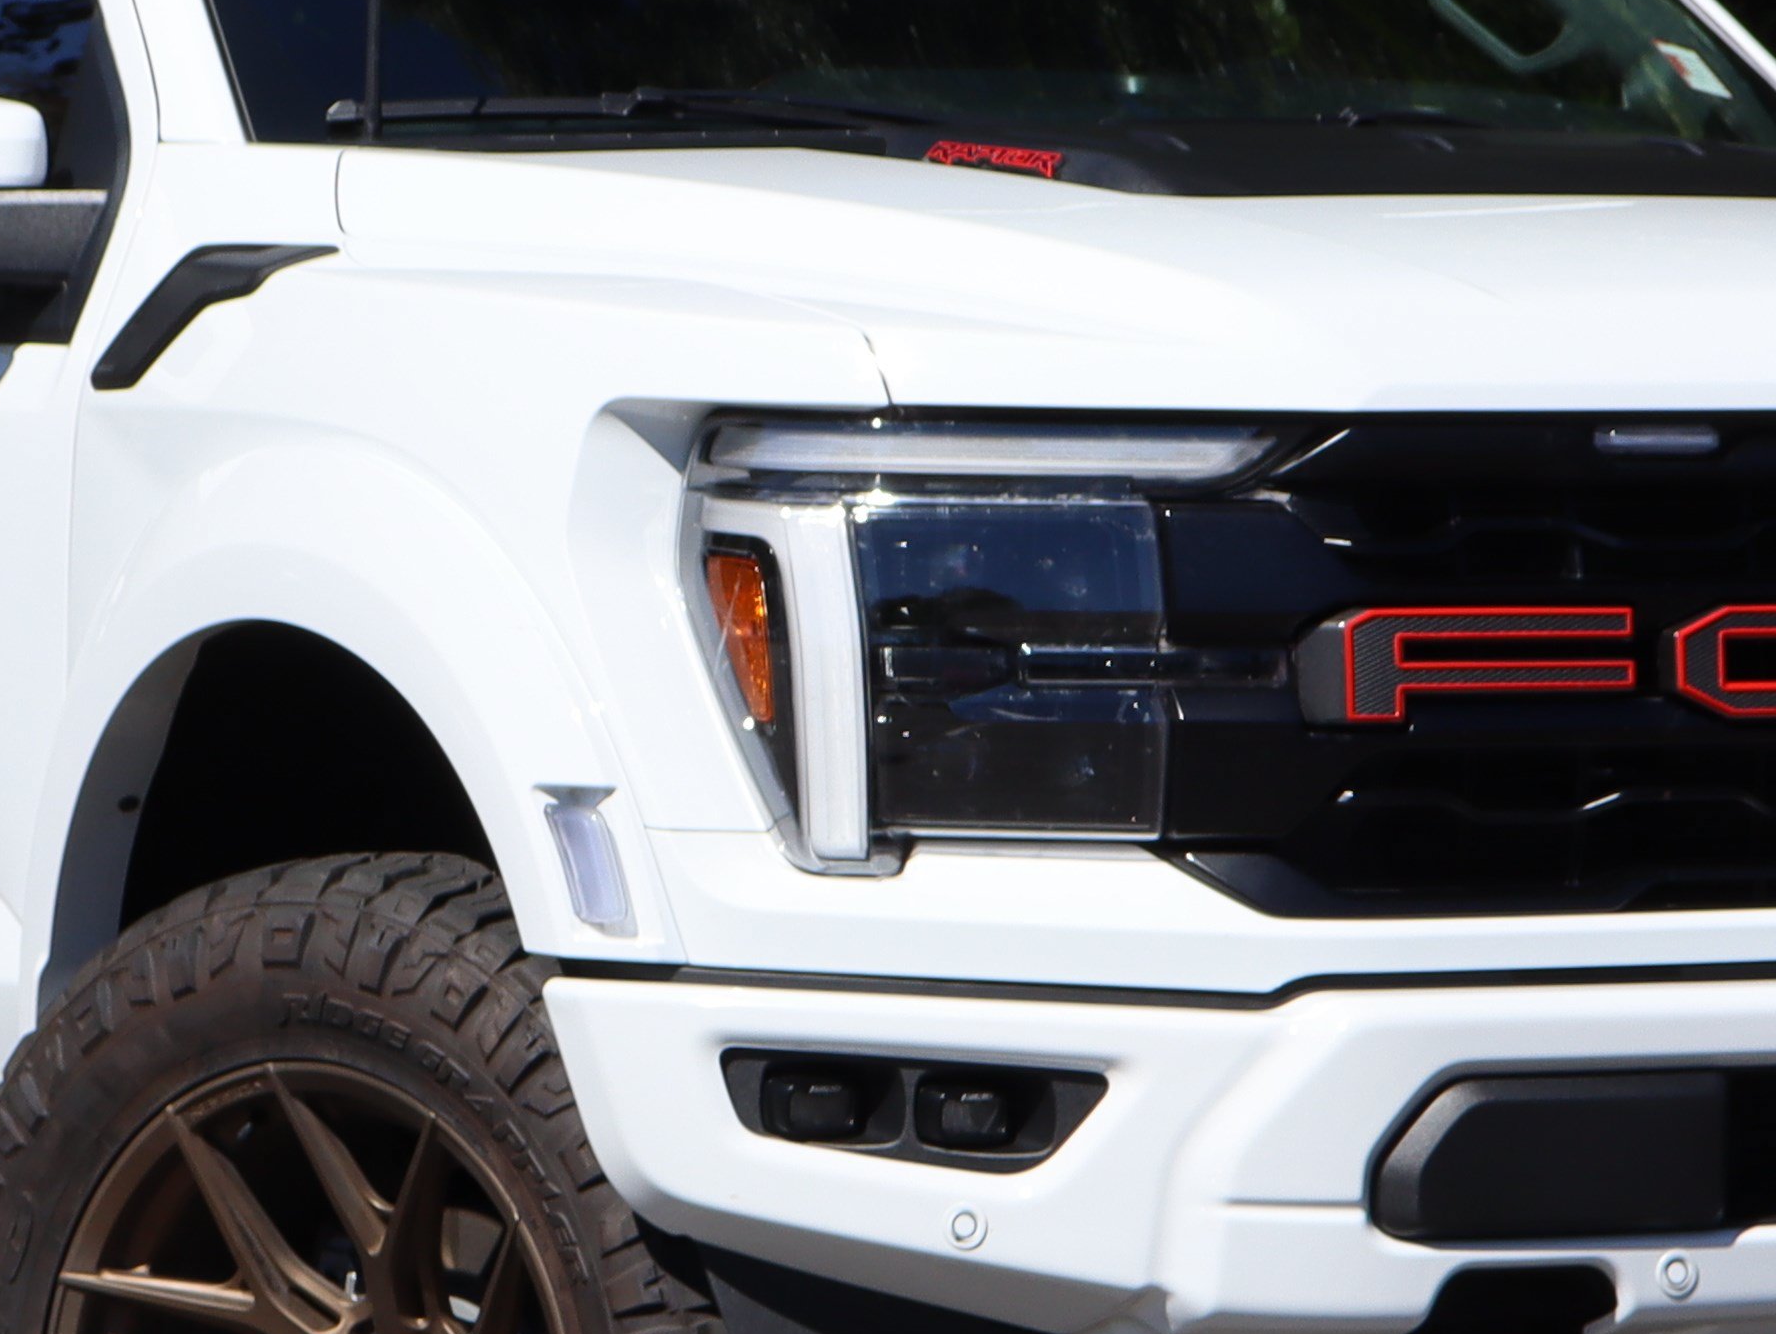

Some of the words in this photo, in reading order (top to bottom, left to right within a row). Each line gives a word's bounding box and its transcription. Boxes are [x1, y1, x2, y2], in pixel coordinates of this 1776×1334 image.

[926, 140, 1062, 179] RAPTOR
[279, 991, 414, 1051] RIDGE
[418, 1037, 591, 1286] GRAPPLER
